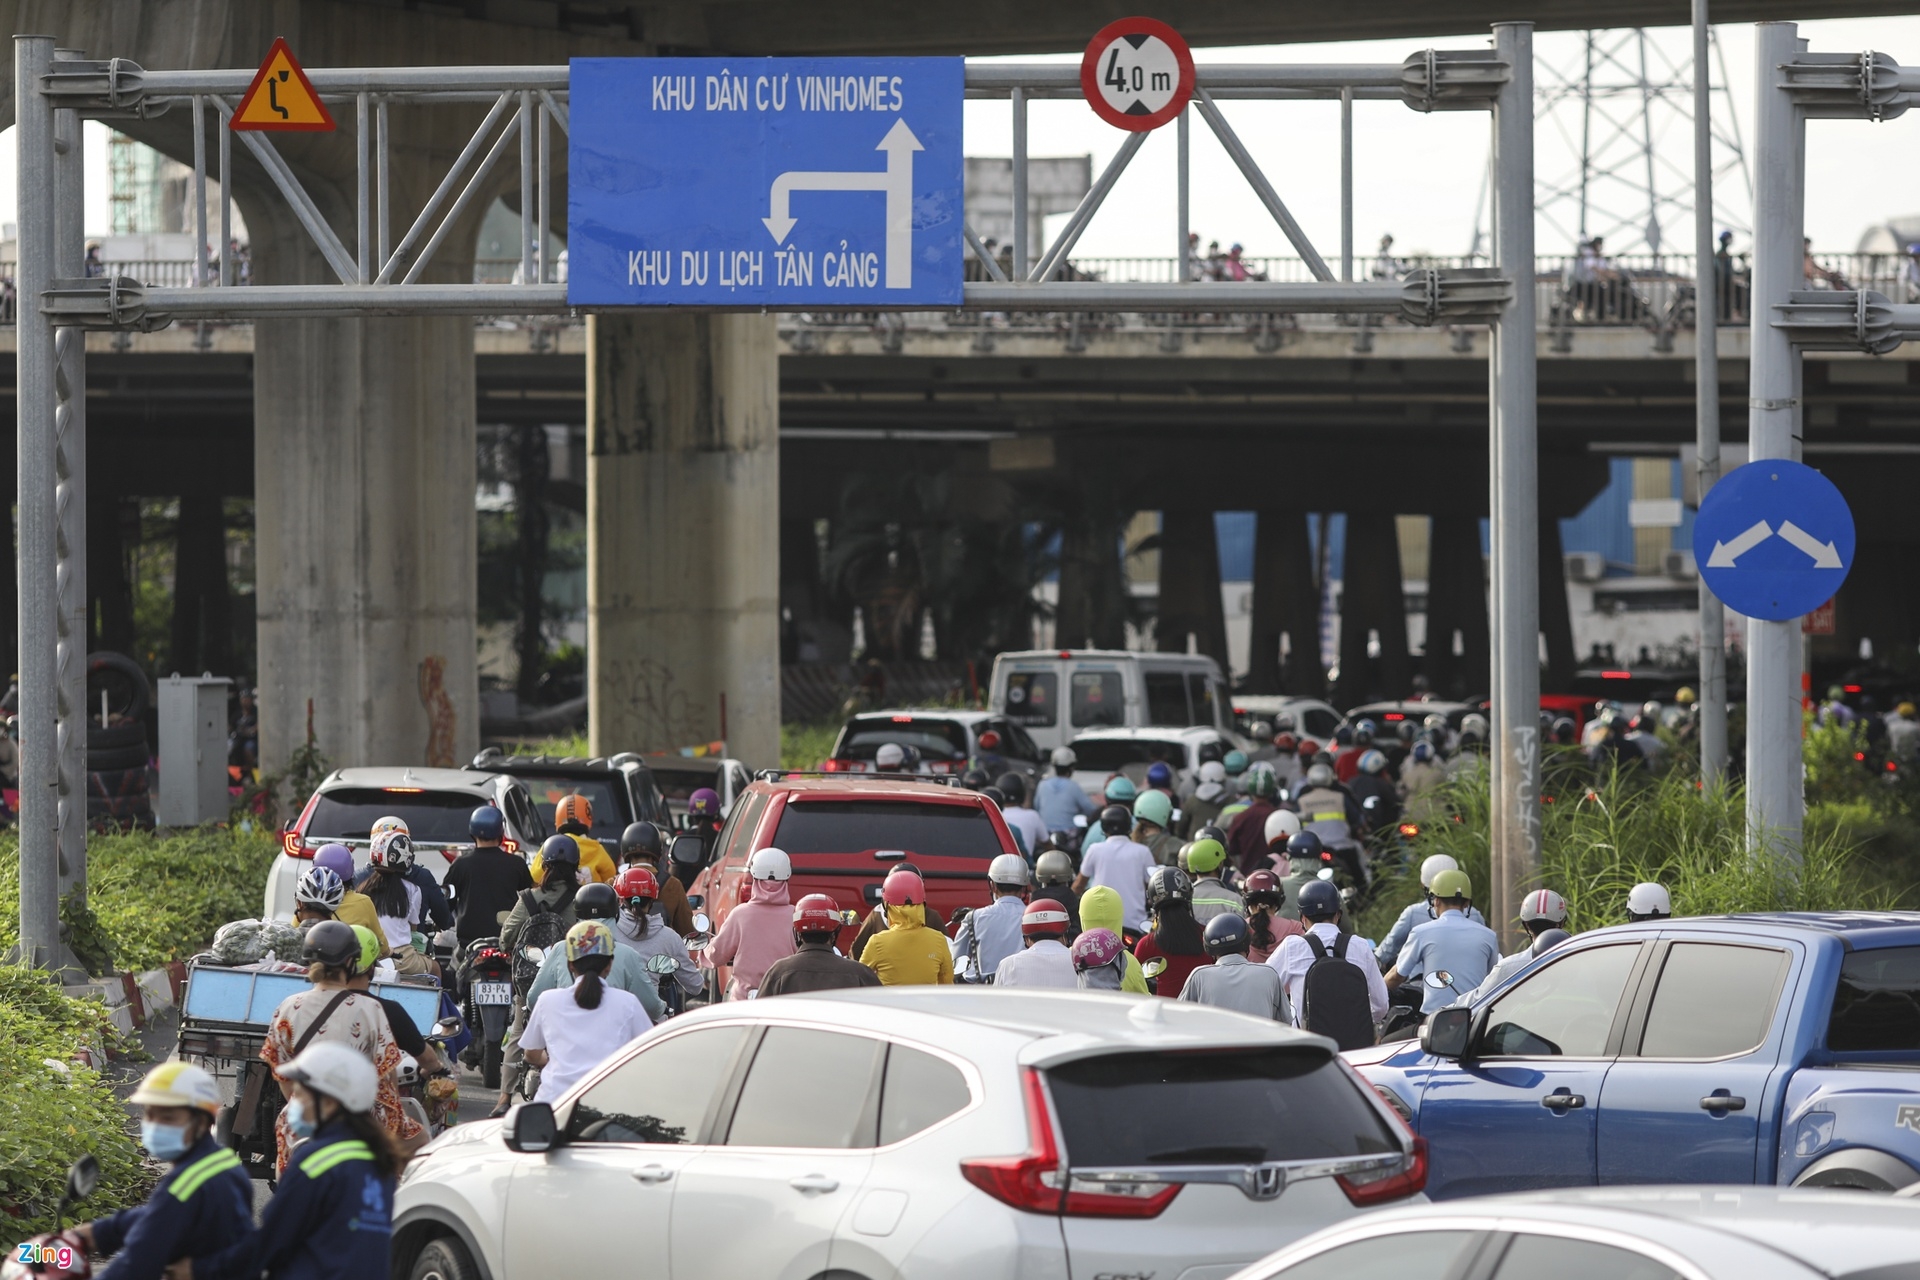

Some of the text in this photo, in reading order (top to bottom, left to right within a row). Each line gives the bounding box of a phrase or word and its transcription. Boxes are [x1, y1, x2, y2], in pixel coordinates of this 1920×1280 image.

[652, 68, 903, 112] KHU DÂN CƯ VINHOMES
[1152, 72, 1171, 91] m
[628, 239, 879, 292] KHU DU LỊCH TÂN CẢNG
[478, 994, 510, 1003] 071.18
